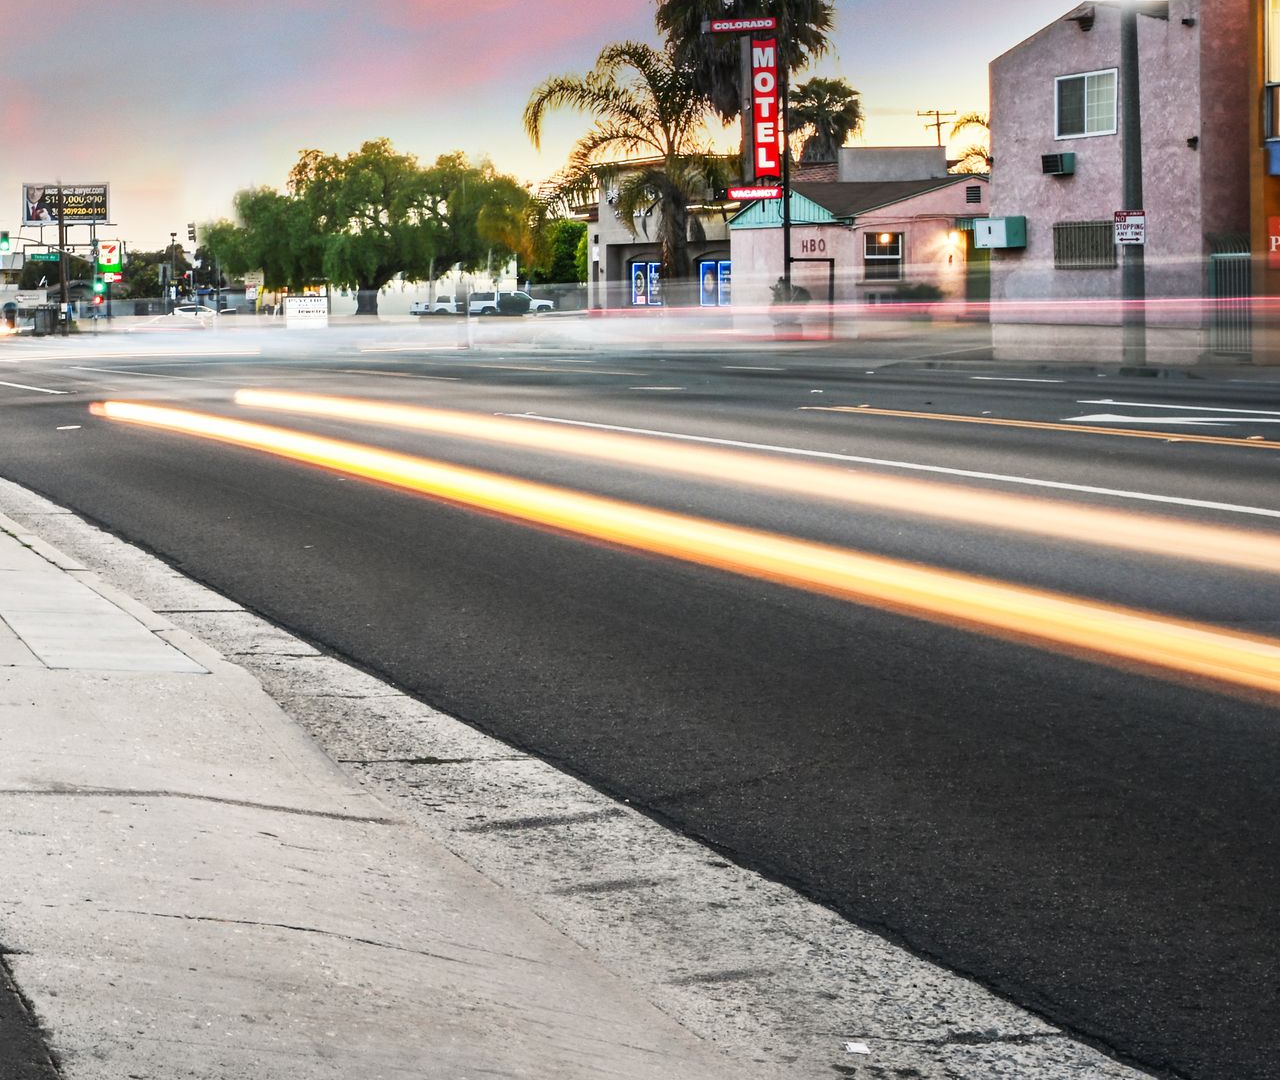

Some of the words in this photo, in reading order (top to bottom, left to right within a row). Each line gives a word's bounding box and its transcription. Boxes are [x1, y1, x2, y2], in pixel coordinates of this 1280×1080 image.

[713, 20, 773, 30] COLORADO
[752, 47, 776, 169] MOTEL
[730, 189, 778, 198] VACANCY
[801, 238, 826, 253] HBO
